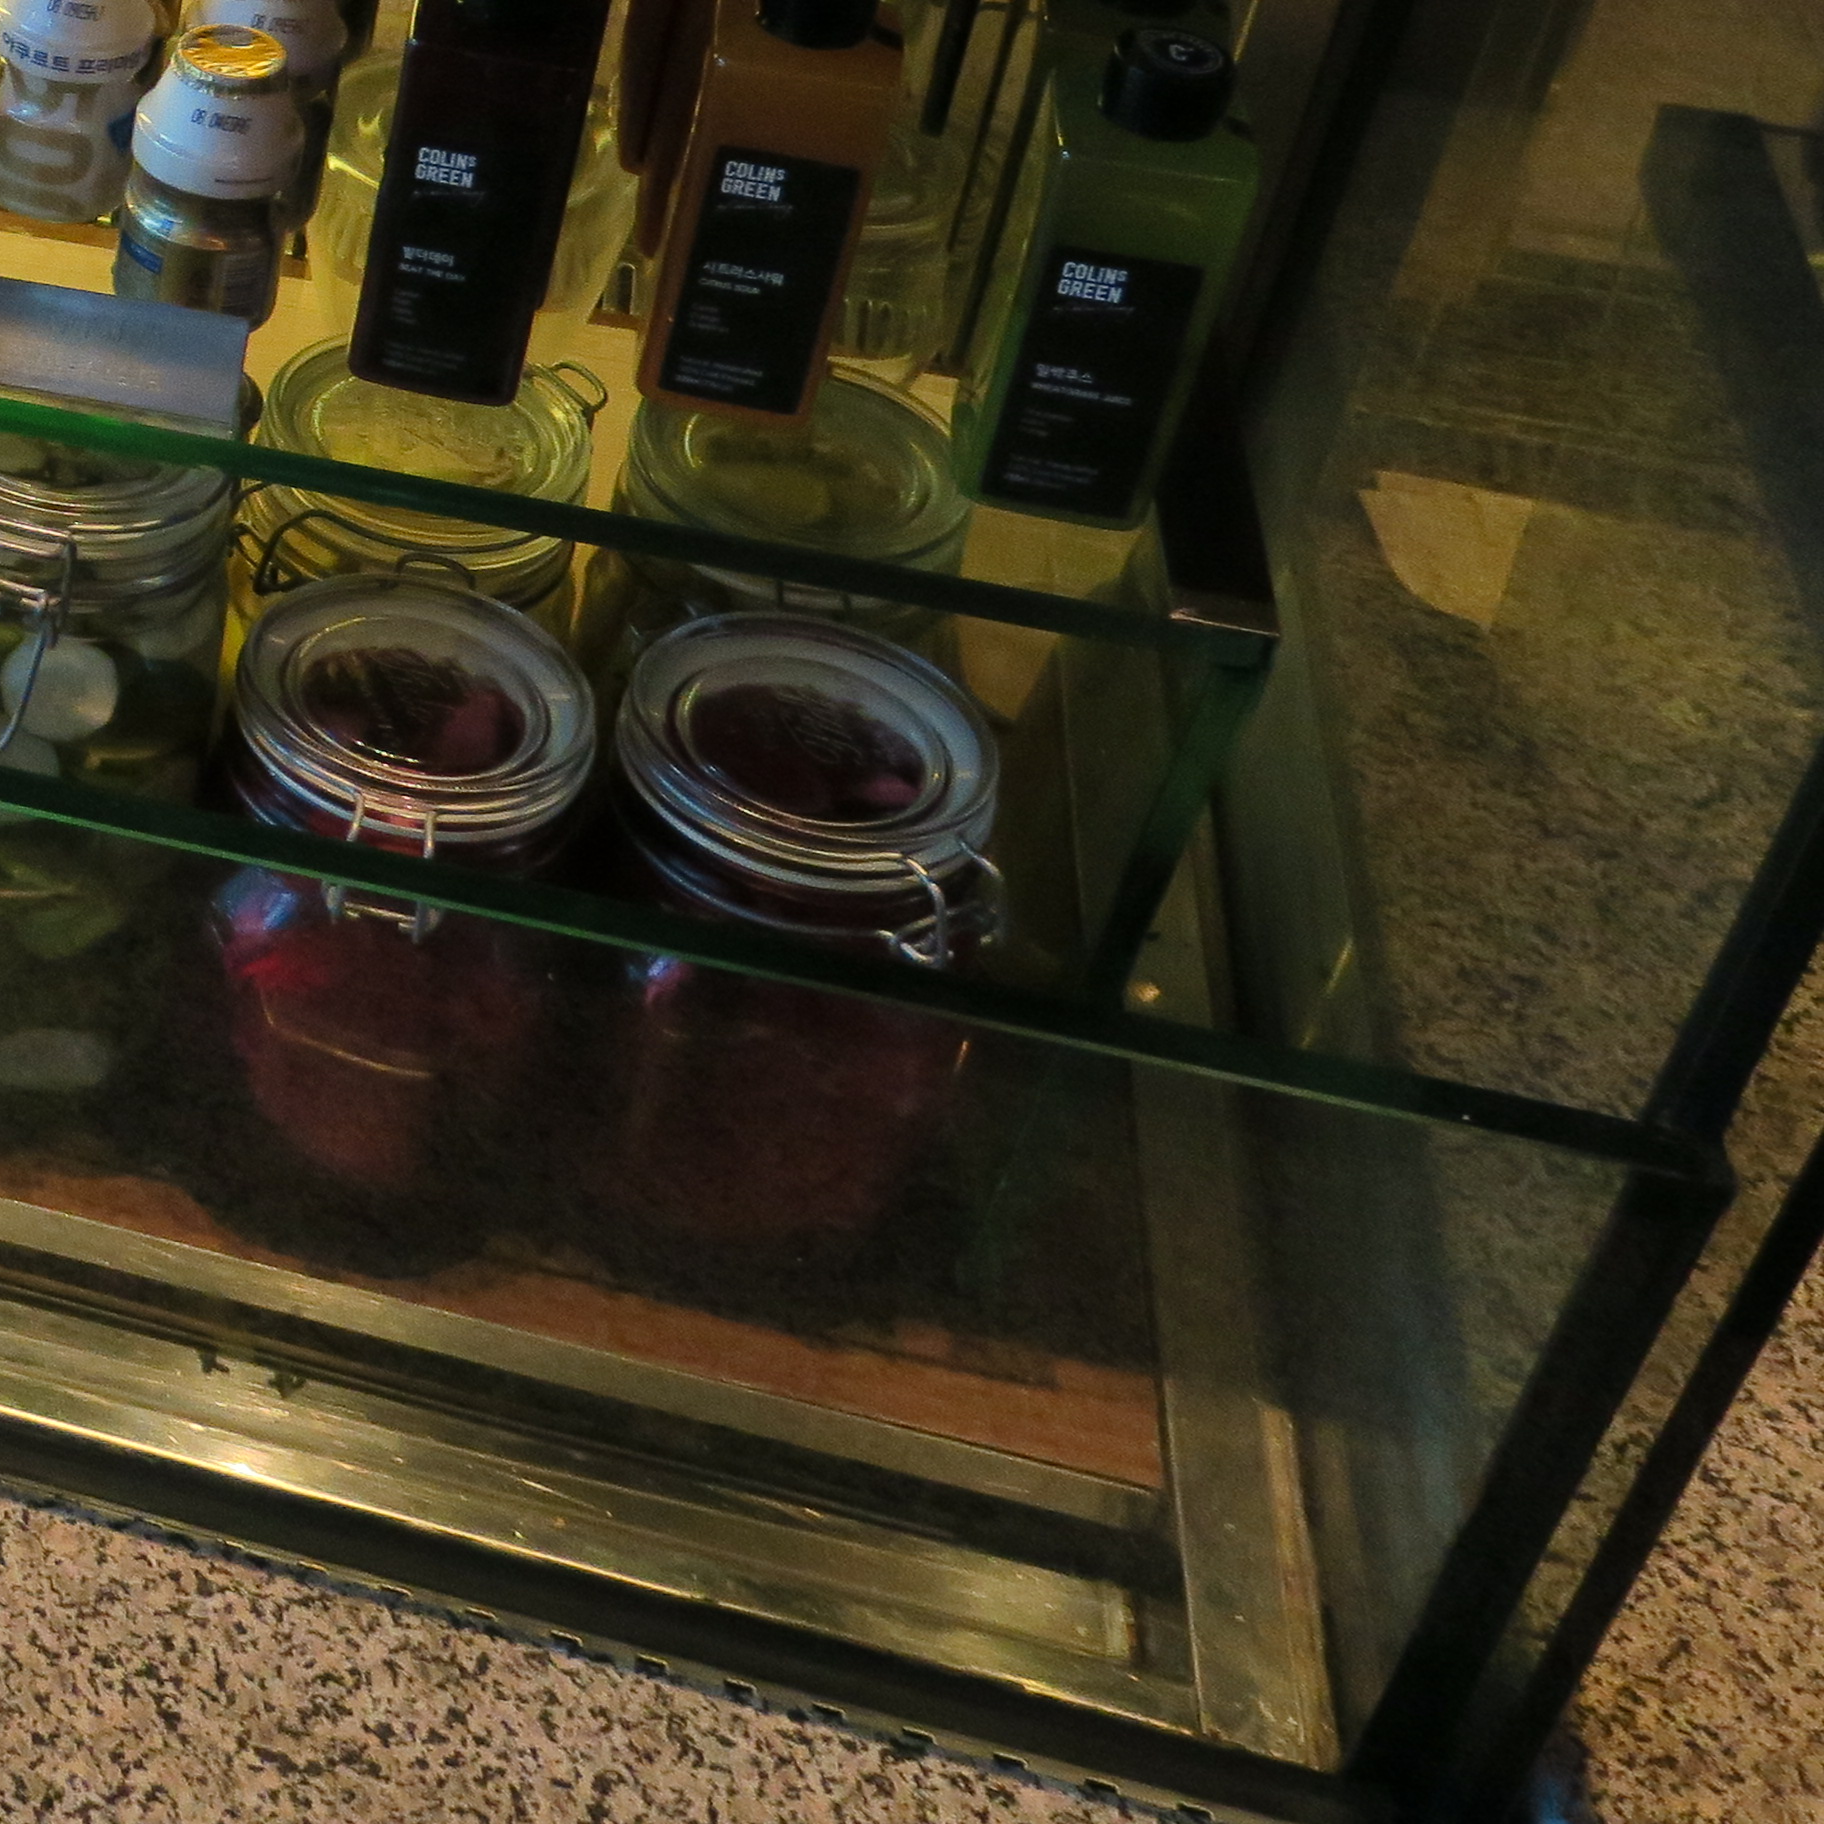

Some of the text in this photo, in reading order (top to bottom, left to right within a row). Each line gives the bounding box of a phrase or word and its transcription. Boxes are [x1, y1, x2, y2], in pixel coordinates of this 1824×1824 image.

[414, 163, 475, 189] GREEN
[719, 177, 782, 202] GREEN
[1056, 278, 1124, 304] GREEN
